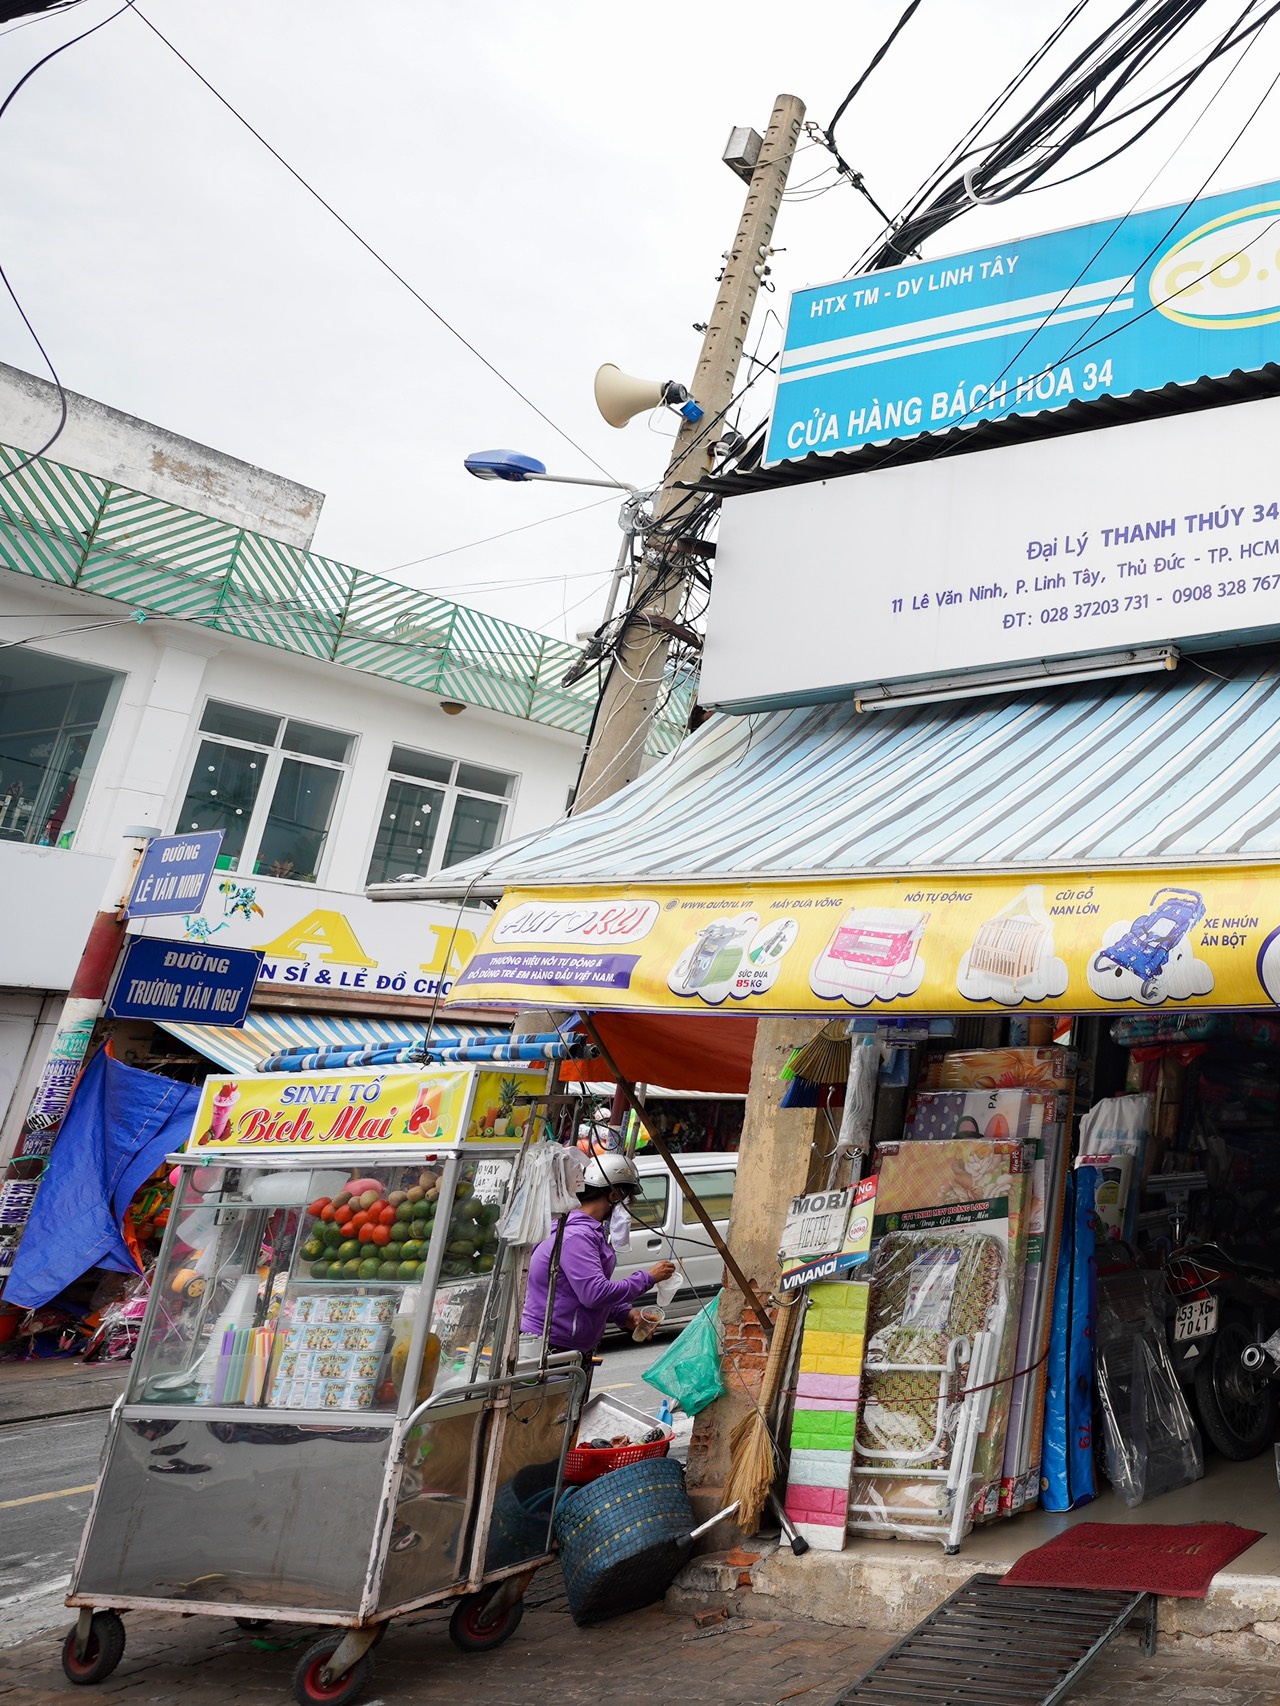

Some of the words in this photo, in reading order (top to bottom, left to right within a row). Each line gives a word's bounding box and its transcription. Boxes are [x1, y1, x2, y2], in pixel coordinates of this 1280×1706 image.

[810, 292, 847, 319] HTX
[853, 286, 880, 308] TM
[895, 278, 923, 299] DV
[928, 265, 974, 291] LINH
[979, 255, 1019, 279] TÂY
[786, 410, 839, 450] CỬA
[847, 396, 922, 438] HÀNG
[930, 379, 1008, 421] BÁCH
[1016, 363, 1075, 403] HÓA
[1082, 358, 1114, 393] 34
[1026, 536, 1058, 563] Đại
[1064, 531, 1089, 560] Lý
[1100, 517, 1176, 549] THANH
[1184, 504, 1245, 535] THÚY
[1252, 501, 1280, 524] 34
[890, 598, 904, 614] 11
[911, 592, 930, 611] Lê
[935, 586, 963, 607] Văn
[968, 582, 1008, 604] Ninh,
[1015, 579, 1029, 596] P.
[1033, 572, 1066, 593] Linh
[1072, 567, 1107, 589] Tây,
[1117, 557, 1147, 579] Thủ
[1153, 552, 1186, 574] Đức
[1207, 548, 1233, 566] TP.
[1239, 539, 1280, 561] HCM
[1002, 610, 1033, 631] ĐT:
[1040, 606, 1070, 625] 028
[1073, 598, 1120, 620] 37203
[1123, 593, 1150, 613] 731
[1171, 583, 1213, 606] 0908
[1216, 578, 1248, 599] 328
[160, 841, 202, 863] ĐƯỜNG
[134, 873, 154, 903] LÊ
[152, 871, 179, 901] VĂN
[174, 873, 206, 900] NINH
[904, 891, 925, 903] NÔI
[925, 890, 941, 905] TỰ
[940, 891, 973, 906] ĐỘNG
[1054, 890, 1075, 902] CŨI
[1075, 885, 1096, 902] GỖ
[1049, 904, 1075, 916] NAN
[1075, 901, 1100, 916] LỚN
[1202, 917, 1220, 929] XE
[1221, 914, 1259, 929] NHÚN
[1200, 932, 1220, 946] ĂN
[1221, 932, 1247, 950] BỘT
[163, 950, 231, 974] ĐƯỜNG
[283, 961, 312, 983] SỈ
[314, 968, 332, 985] &
[339, 966, 369, 988] LẺ
[376, 970, 408, 991] ĐỒ
[182, 980, 213, 1011] VĂN
[211, 986, 244, 1013] NGƯ
[279, 1083, 344, 1106] SINH
[347, 1074, 388, 1104] TỐ
[237, 1106, 315, 1143] Bích
[319, 1104, 400, 1142] Mai
[1179, 1316, 1209, 1338] 7041
